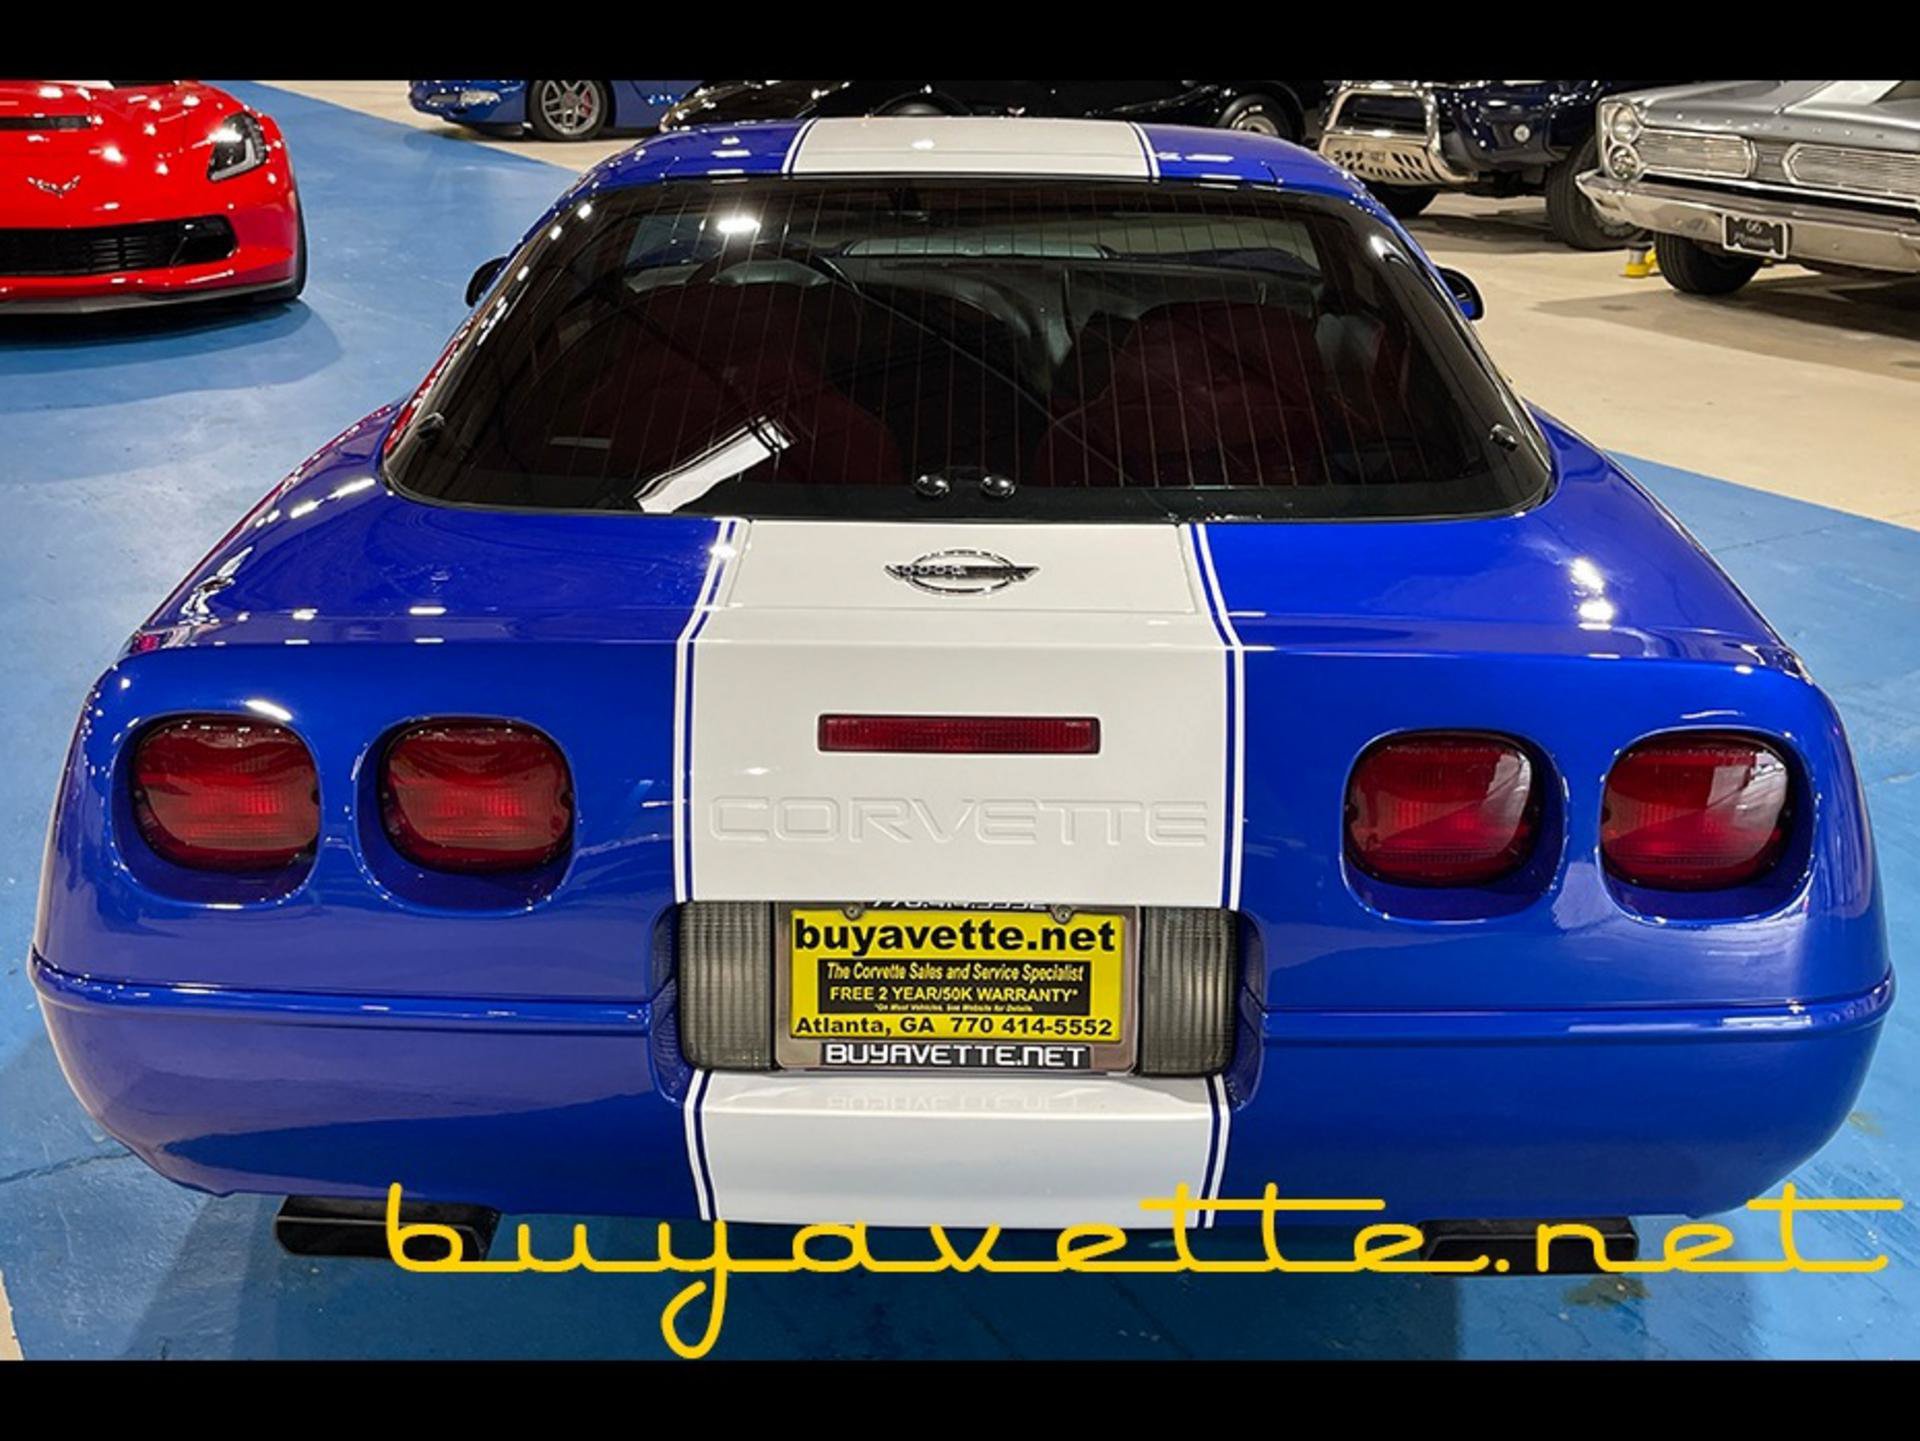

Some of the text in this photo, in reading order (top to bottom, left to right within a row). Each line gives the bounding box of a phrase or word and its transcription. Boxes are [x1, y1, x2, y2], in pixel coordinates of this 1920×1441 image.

[708, 795, 1208, 847] CORVETTE
[795, 918, 1115, 956] buyavette.net
[827, 961, 1084, 984] The Corvette Sales and Service Specialist
[830, 986, 875, 1001] FREE
[878, 986, 888, 1001] 2
[891, 986, 973, 1002] YEAR/50K
[796, 1017, 1113, 1036] Atlanta, GA 770 414-5552
[825, 1043, 1086, 1067] BUYAVETTE.NET
